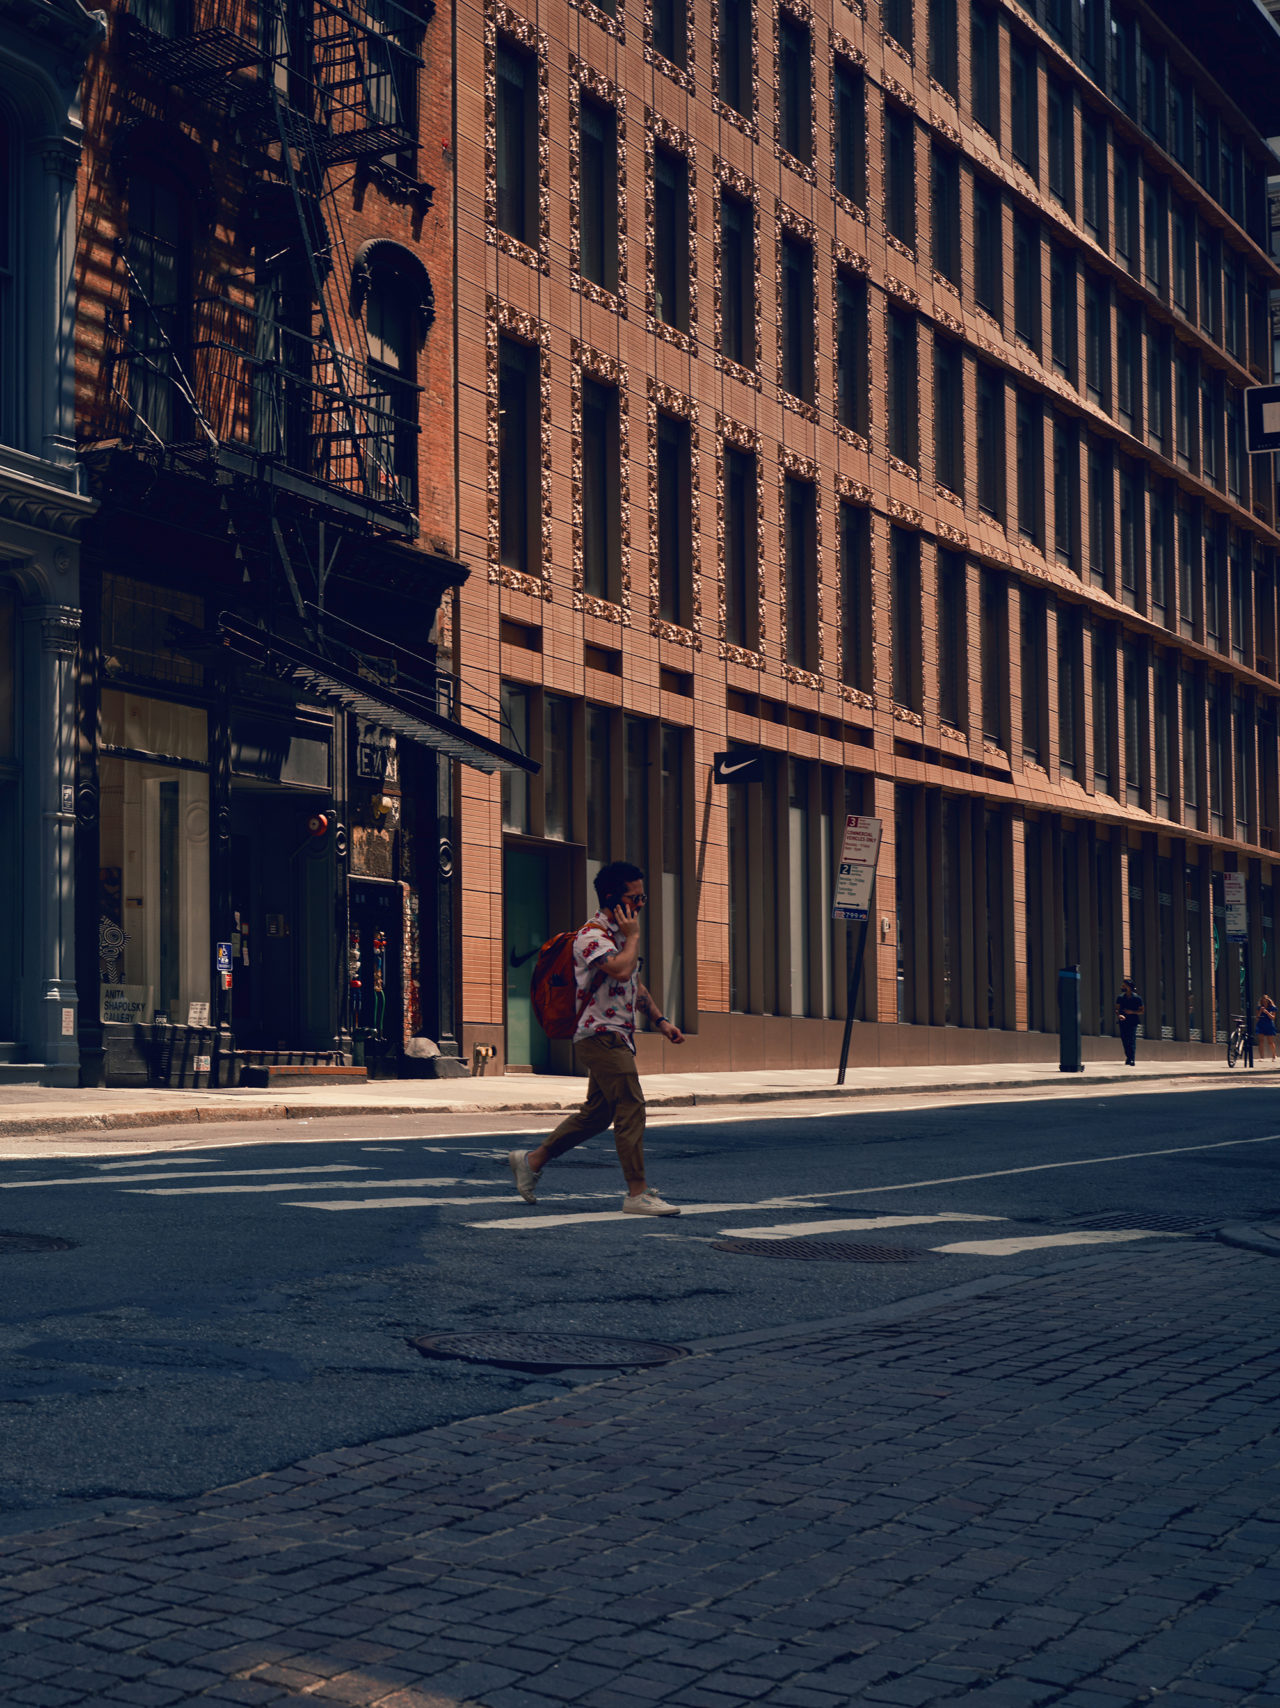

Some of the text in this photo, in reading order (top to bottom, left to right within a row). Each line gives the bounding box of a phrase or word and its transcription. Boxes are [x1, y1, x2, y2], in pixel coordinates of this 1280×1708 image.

[849, 817, 857, 827] 3
[841, 865, 849, 874] 2
[105, 990, 124, 999] ANITA
[104, 1000, 146, 1012] SHAPOLSKY
[104, 1012, 136, 1022] GALLERY
